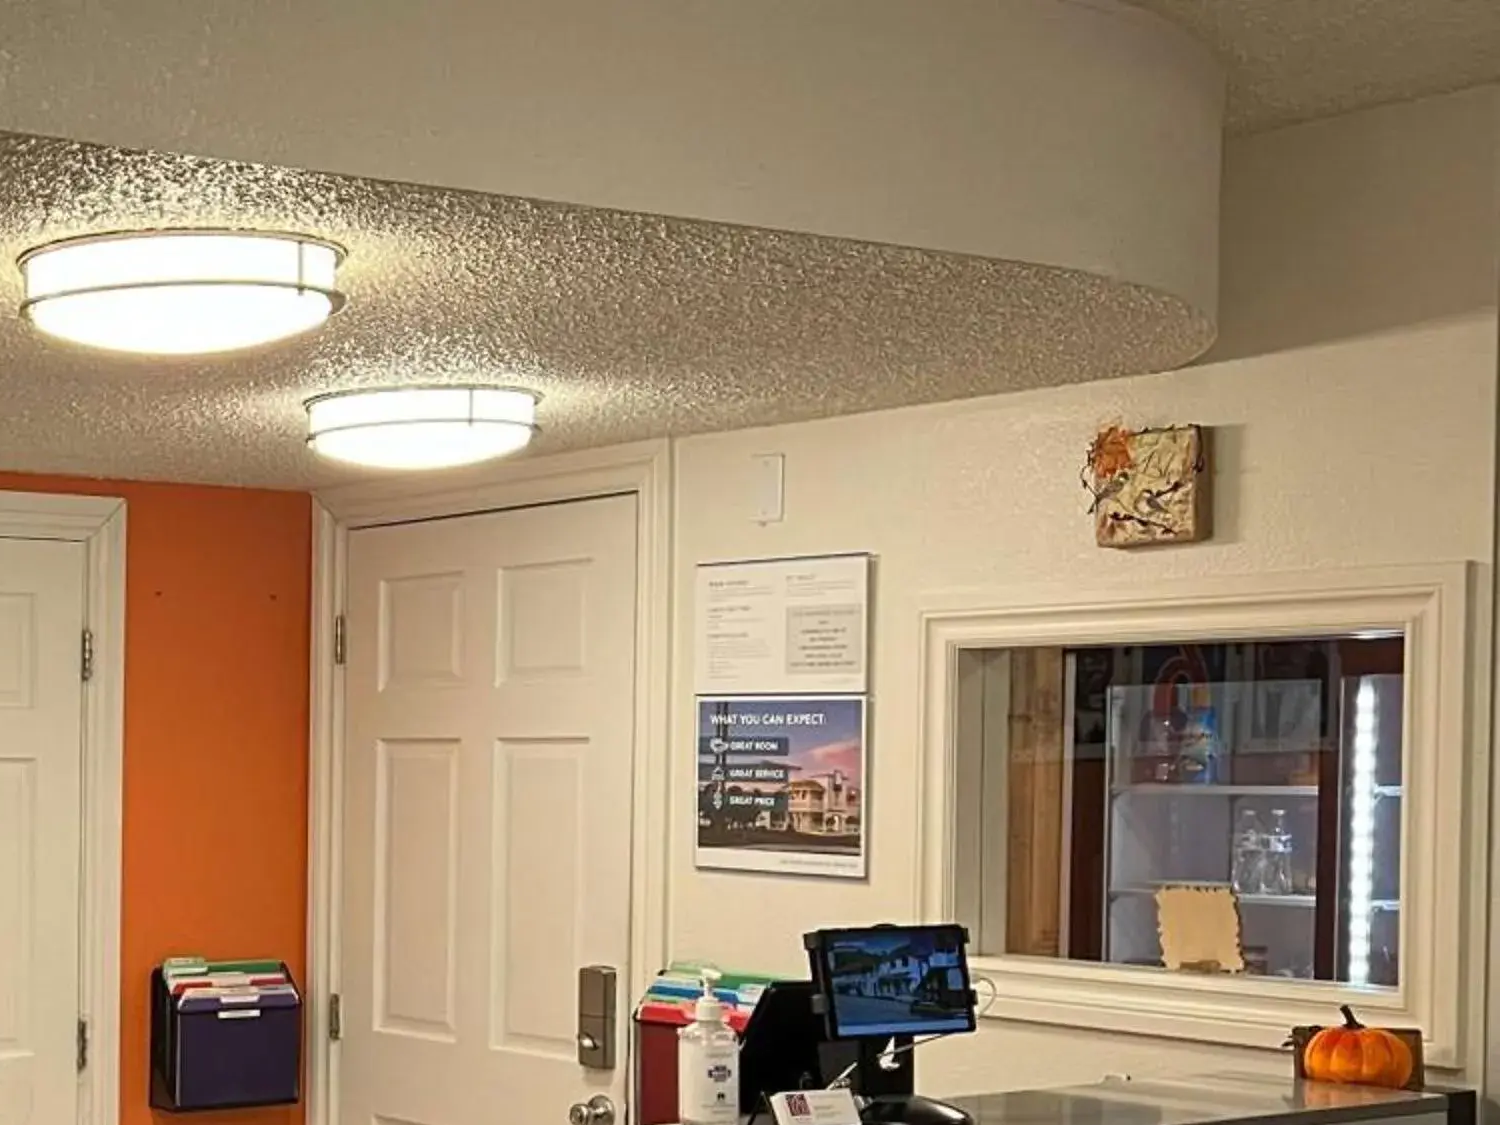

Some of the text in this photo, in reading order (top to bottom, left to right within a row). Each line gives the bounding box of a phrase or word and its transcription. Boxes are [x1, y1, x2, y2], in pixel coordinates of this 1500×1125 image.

[710, 713, 738, 725] WHAT
[740, 713, 761, 725] YOU
[763, 713, 784, 725] CAN
